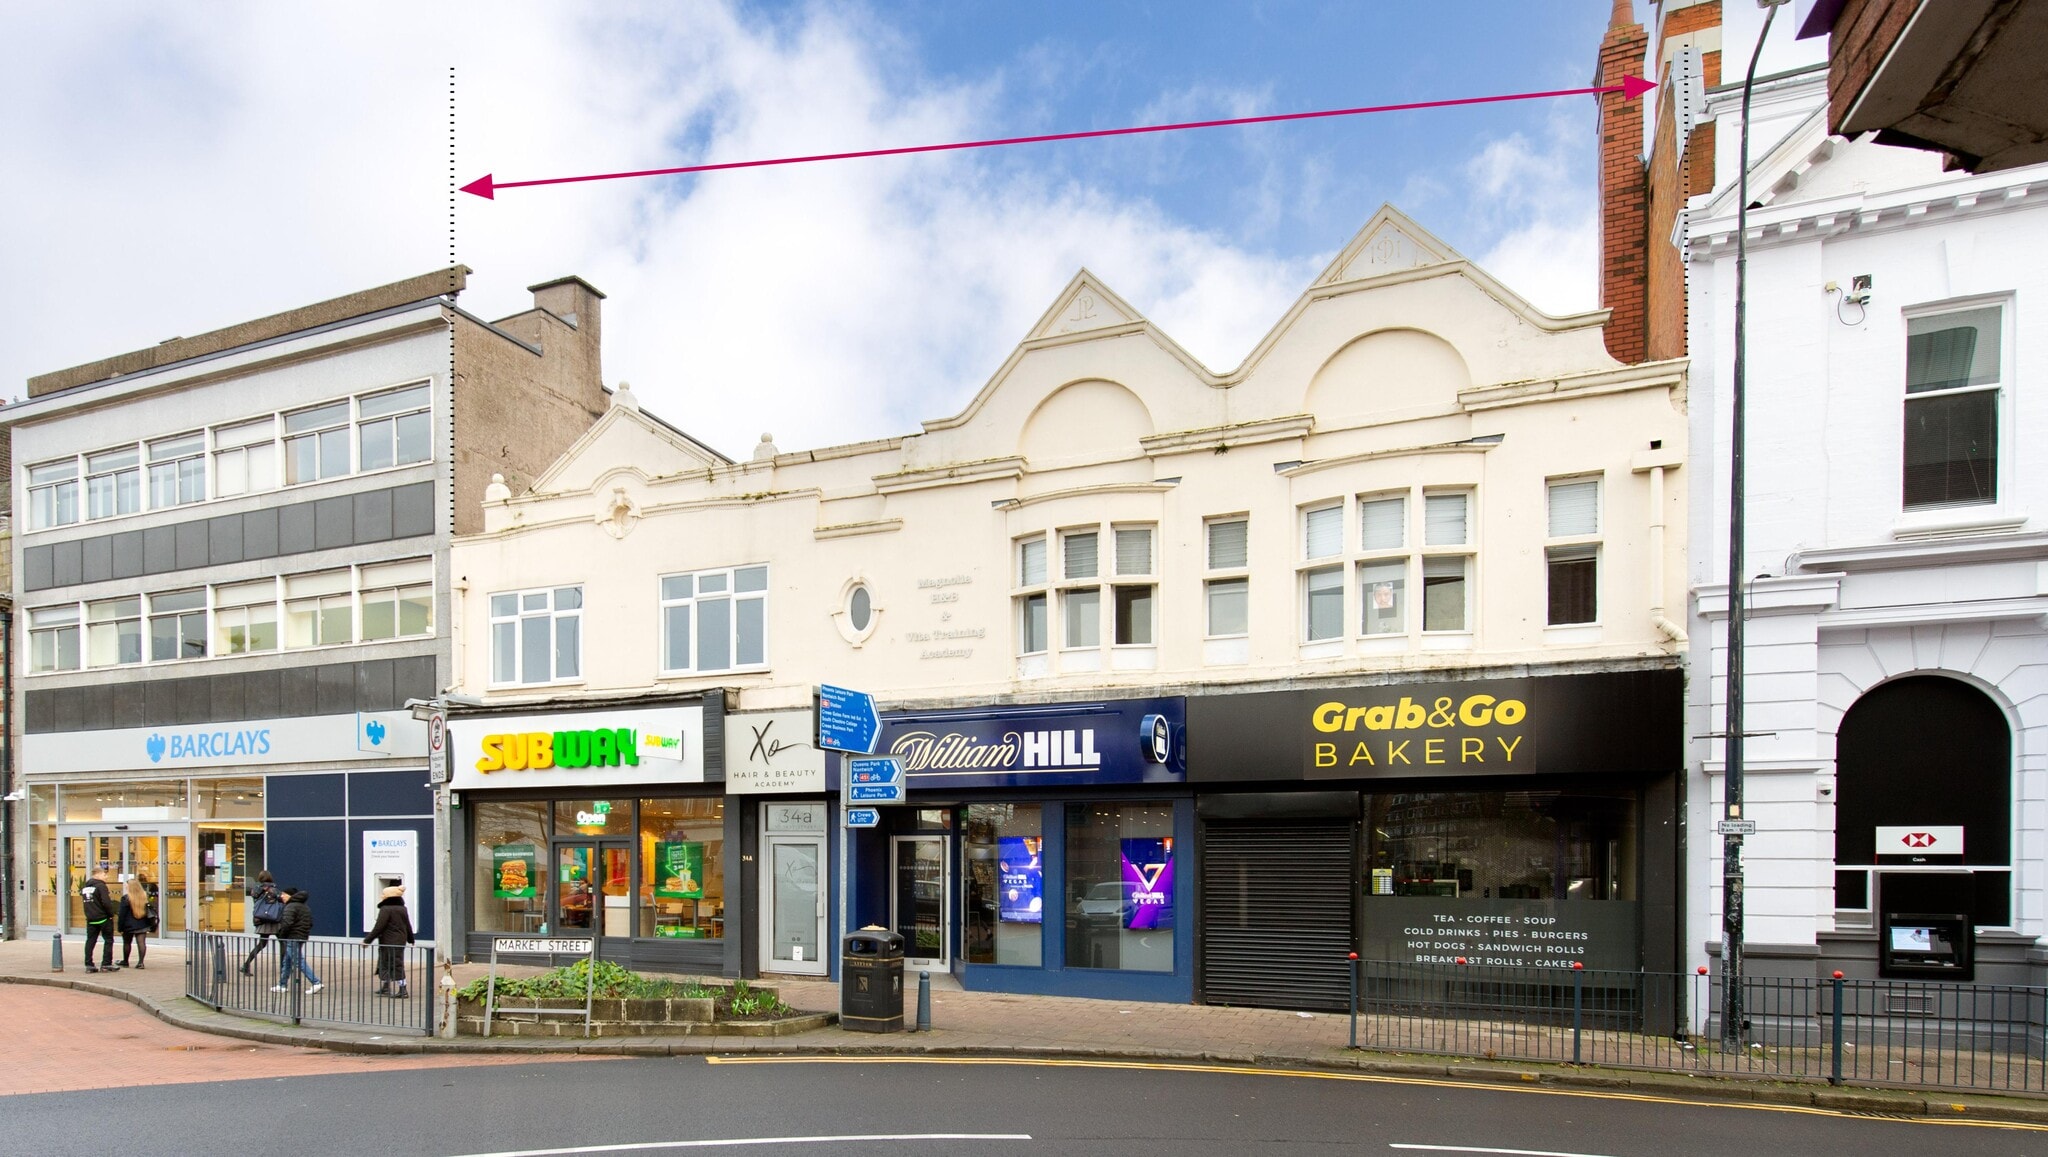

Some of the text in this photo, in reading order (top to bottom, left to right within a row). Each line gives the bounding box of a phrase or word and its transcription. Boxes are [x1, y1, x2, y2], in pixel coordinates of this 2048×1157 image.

[920, 648, 973, 660] Academy
[1312, 694, 1527, 733] Grab&Go
[170, 729, 270, 758] BARCLAYS
[645, 734, 680, 749] SUBWAY
[475, 728, 640, 775] SUBWAY
[890, 729, 1101, 771] William HILL
[1315, 736, 1523, 767] BAKERY
[775, 769, 816, 778] BEAUTY
[576, 811, 606, 825] Open
[780, 809, 812, 824] 34a
[1433, 915, 1556, 925] TEA COFFEE SOUP
[1404, 927, 1588, 940] COLD DRINKS PIES BURGERS
[498, 940, 588, 951] MARKET STREET
[1407, 941, 1584, 954] HOT DOGS SANDWICH ROLLS
[1486, 957, 1523, 966] ROLLS
[1535, 959, 1575, 968] CAKES
